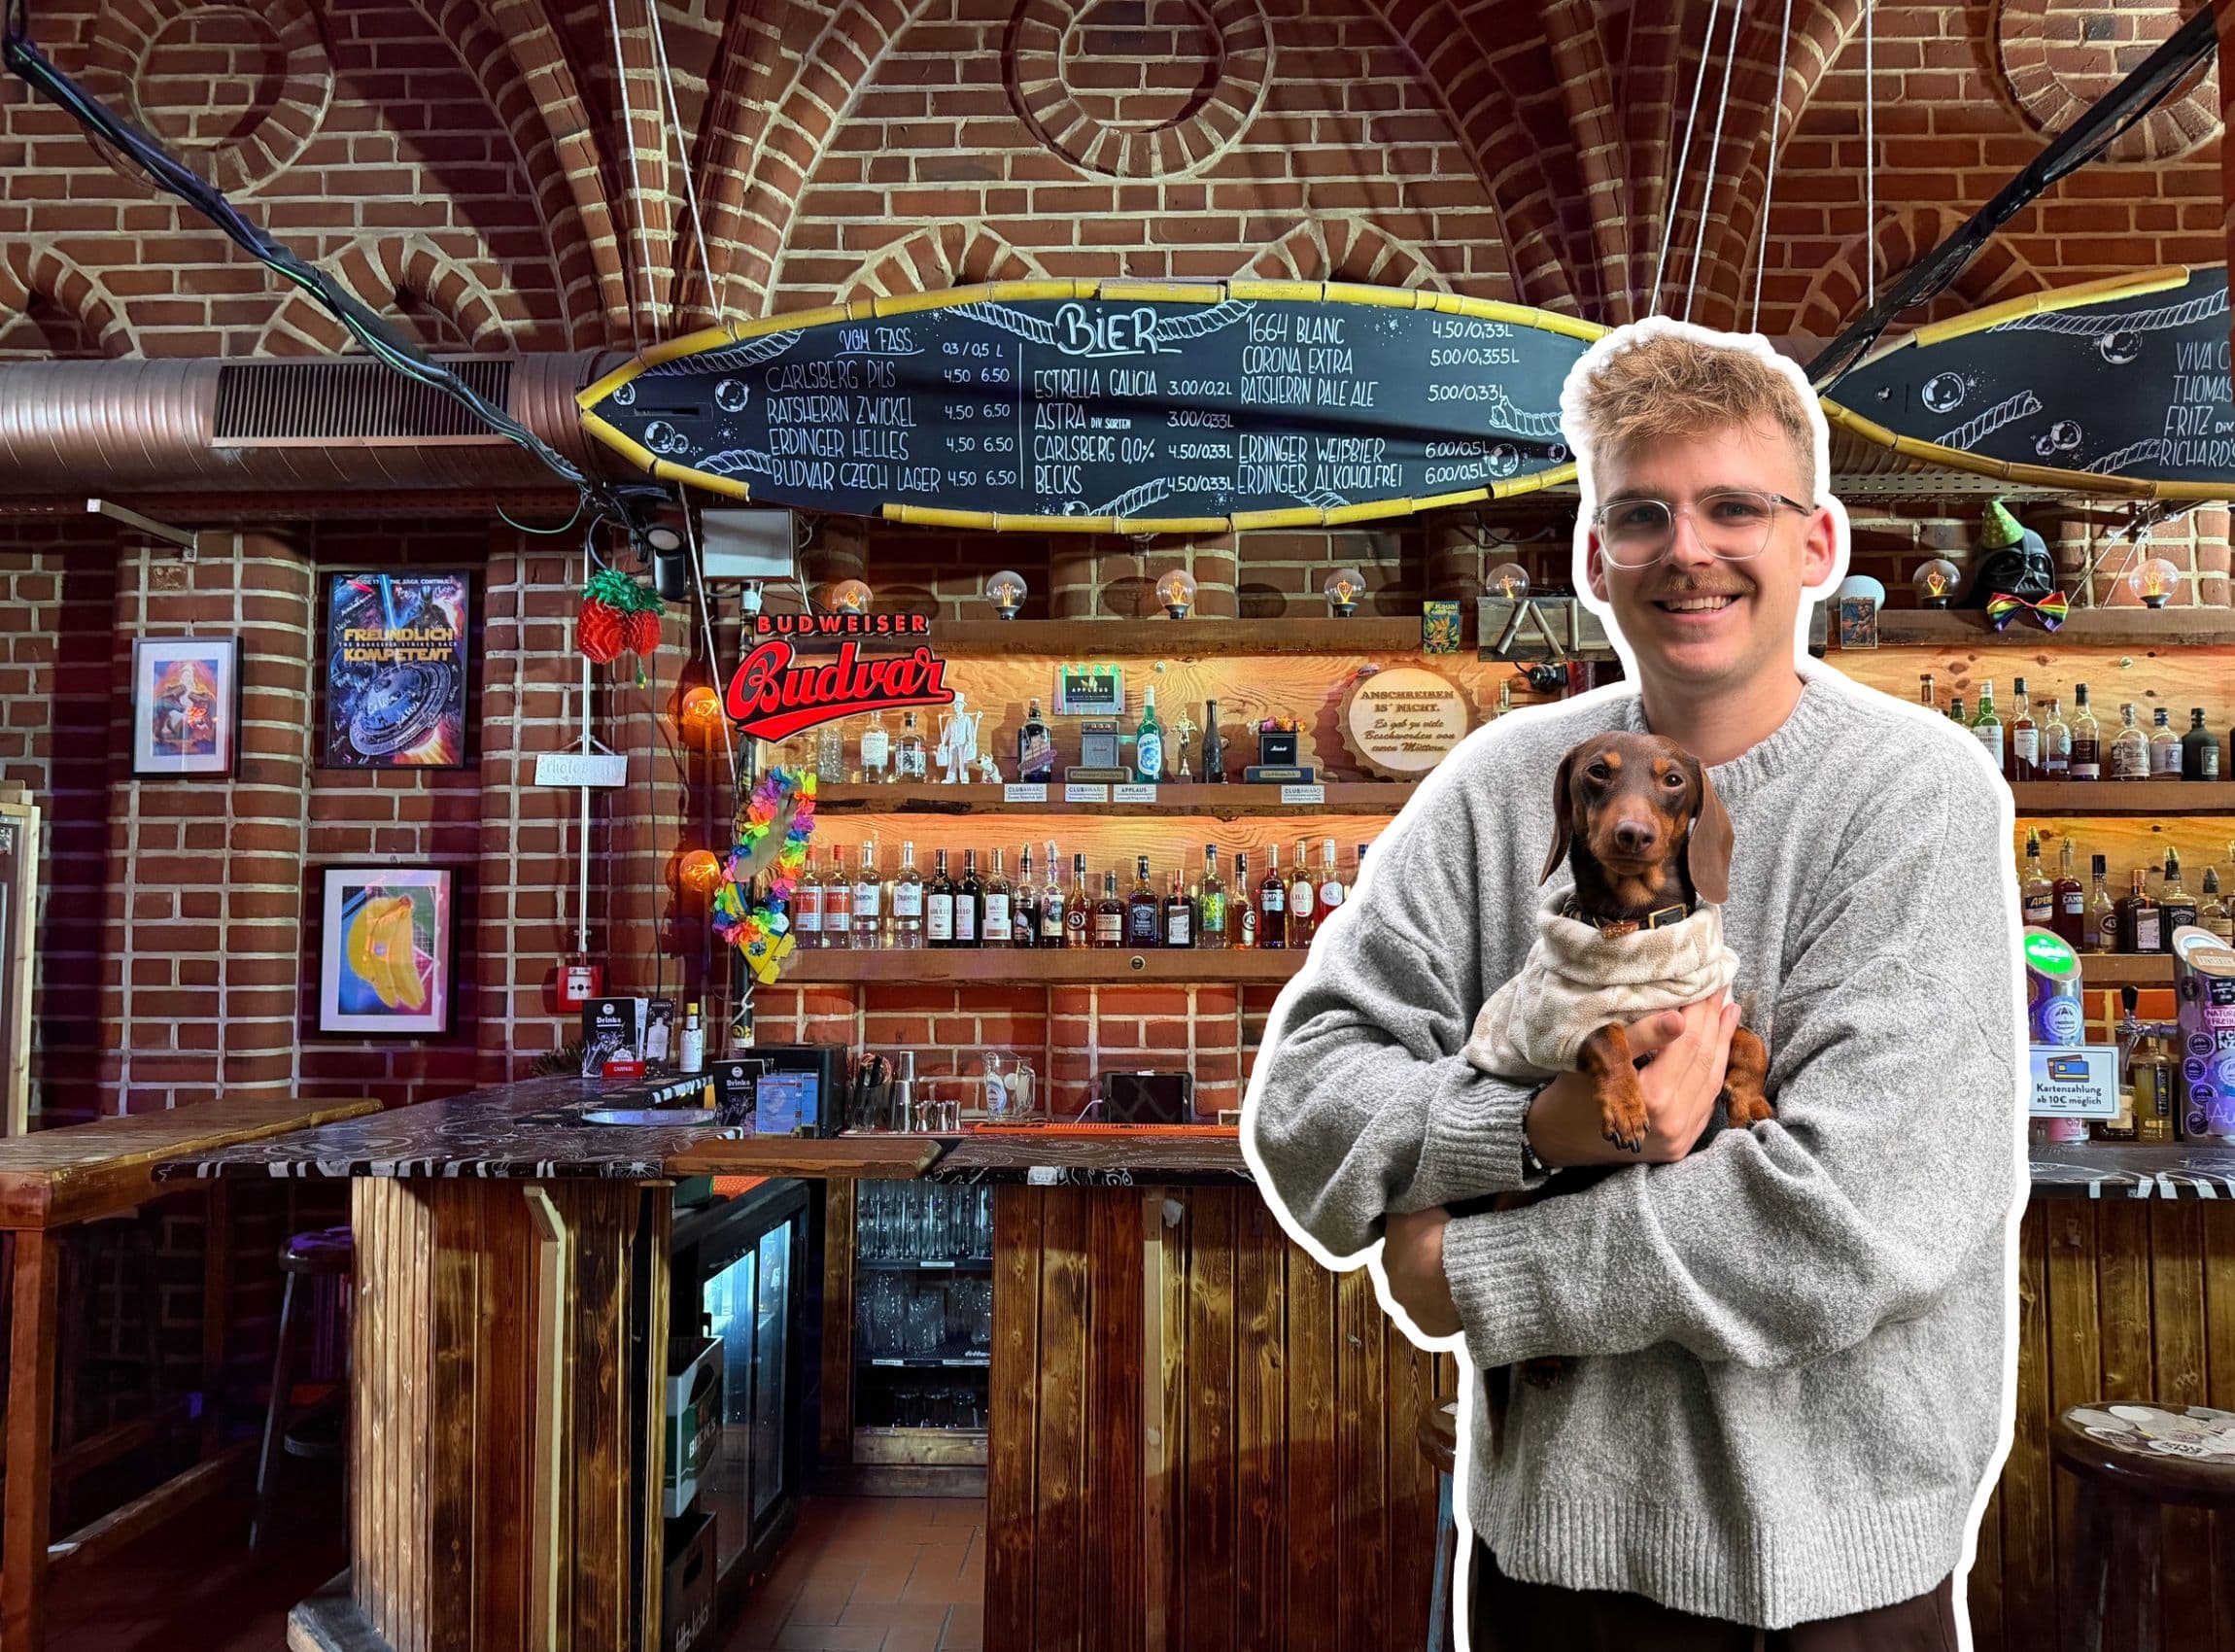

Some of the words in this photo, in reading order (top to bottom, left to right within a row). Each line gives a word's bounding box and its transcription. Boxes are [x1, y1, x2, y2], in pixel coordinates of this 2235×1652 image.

[1246, 313, 1289, 343] 1664
[1296, 316, 1345, 344] BLANC
[1243, 345, 1302, 374] CORONA
[1308, 347, 1353, 375] EXTRA
[2177, 341, 2212, 372] VIVA
[765, 361, 858, 393] CARLSBERG
[944, 369, 971, 383] 4.50
[980, 368, 1011, 383] 6.50
[1034, 368, 1101, 399] ESTRELLA
[1241, 375, 1312, 405] RATSHERRN
[1317, 378, 1349, 406] PALE
[1350, 380, 1380, 407] ALE
[767, 396, 849, 424] RATSHERRN
[945, 405, 974, 421] 4.50
[983, 403, 1011, 418] 6.50
[1035, 402, 1086, 430] ASTRA
[769, 428, 845, 459] ERDINGER
[852, 429, 910, 461] HELLES
[946, 437, 976, 454] 4.50
[983, 437, 1014, 452] 6.50
[1034, 435, 1116, 463] CARLSBERG
[1239, 434, 1308, 465] ERDINGER
[773, 459, 835, 490] BUDVAR
[840, 463, 888, 490] CZECH
[897, 465, 941, 493] LAGER
[947, 471, 977, 487] 4.50
[985, 470, 1017, 486] 6.50
[1035, 465, 1083, 495] BECKS
[1238, 464, 1308, 495] ERDINGER
[344, 628, 453, 641] FREUNDLICH
[756, 614, 928, 634] BUDWEISER
[344, 648, 453, 662] KOMPETENT
[726, 640, 954, 720] Budvar
[1360, 690, 1455, 700] ANSCHREIBEN
[1363, 730, 1432, 740] Beschwerden
[2037, 1084, 2102, 1097] Kartenzahlung
[2069, 1096, 2102, 1107] möglich
